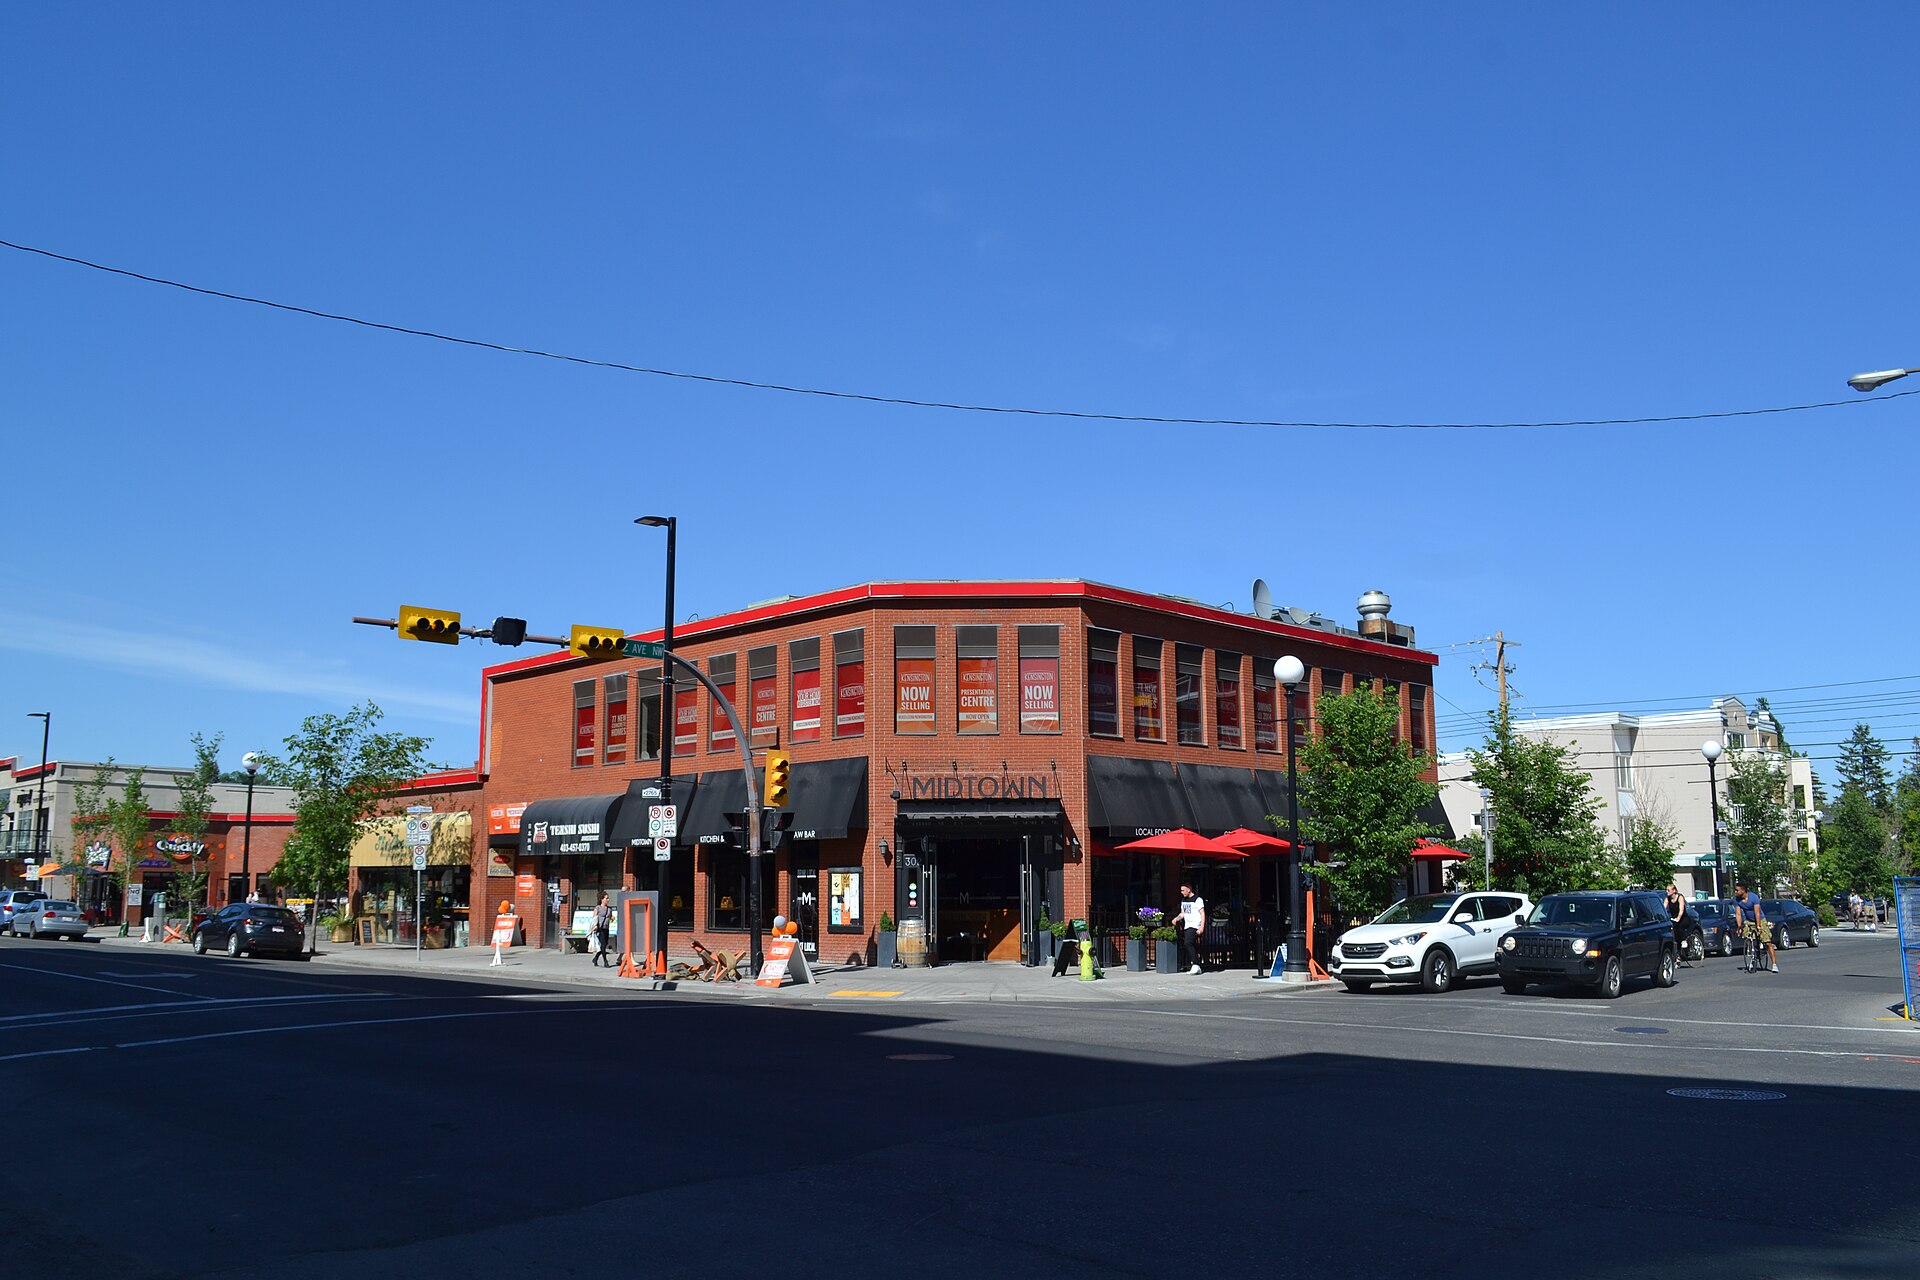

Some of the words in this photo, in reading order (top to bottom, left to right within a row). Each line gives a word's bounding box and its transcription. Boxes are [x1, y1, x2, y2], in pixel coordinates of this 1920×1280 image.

[631, 643, 647, 655] AVE
[652, 646, 663, 657] NW
[901, 686, 930, 701] NOW
[1024, 685, 1053, 700] NOW
[901, 701, 930, 711] SELLING
[961, 695, 995, 707] CENTRE
[1024, 700, 1054, 710] SELLING
[756, 710, 776, 723] CENTRE
[912, 776, 1047, 799] MIDTOWN
[549, 824, 577, 836] TENSHI
[577, 822, 600, 835] SUSHI
[793, 831, 804, 839] AW
[804, 830, 816, 838] BAR
[1135, 827, 1154, 836] LOCAL
[1154, 828, 1171, 836] FOOD
[700, 835, 720, 843] KITCHEN
[801, 891, 812, 906] M
